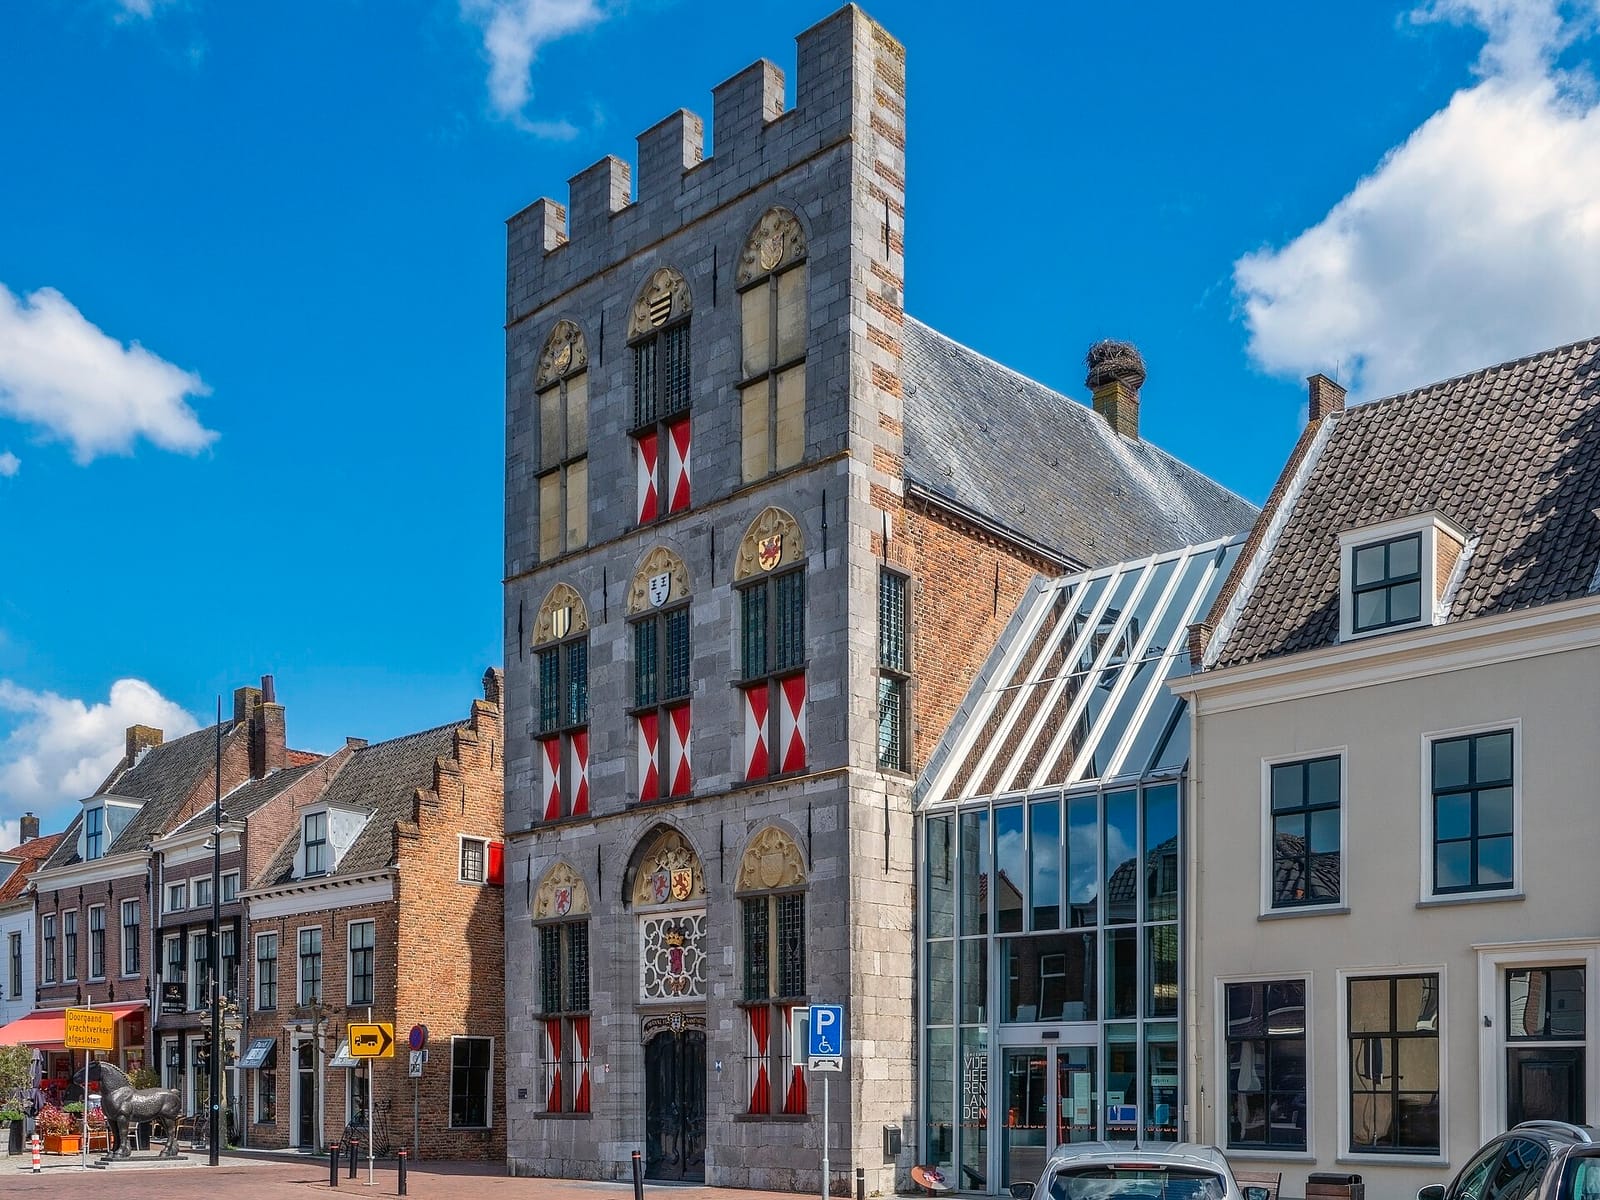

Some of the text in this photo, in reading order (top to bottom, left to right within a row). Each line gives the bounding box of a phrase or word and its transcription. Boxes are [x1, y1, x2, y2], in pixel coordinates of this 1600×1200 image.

[69, 1012, 102, 1023] Doorgaand
[816, 1009, 835, 1035] P
[69, 1025, 113, 1034] vrachtverkeer
[69, 1034, 101, 1045] afgesloten
[963, 1069, 987, 1081] HEE
[963, 1082, 987, 1094] REN
[963, 1094, 987, 1107] LAN
[963, 1106, 987, 1119] DEN
